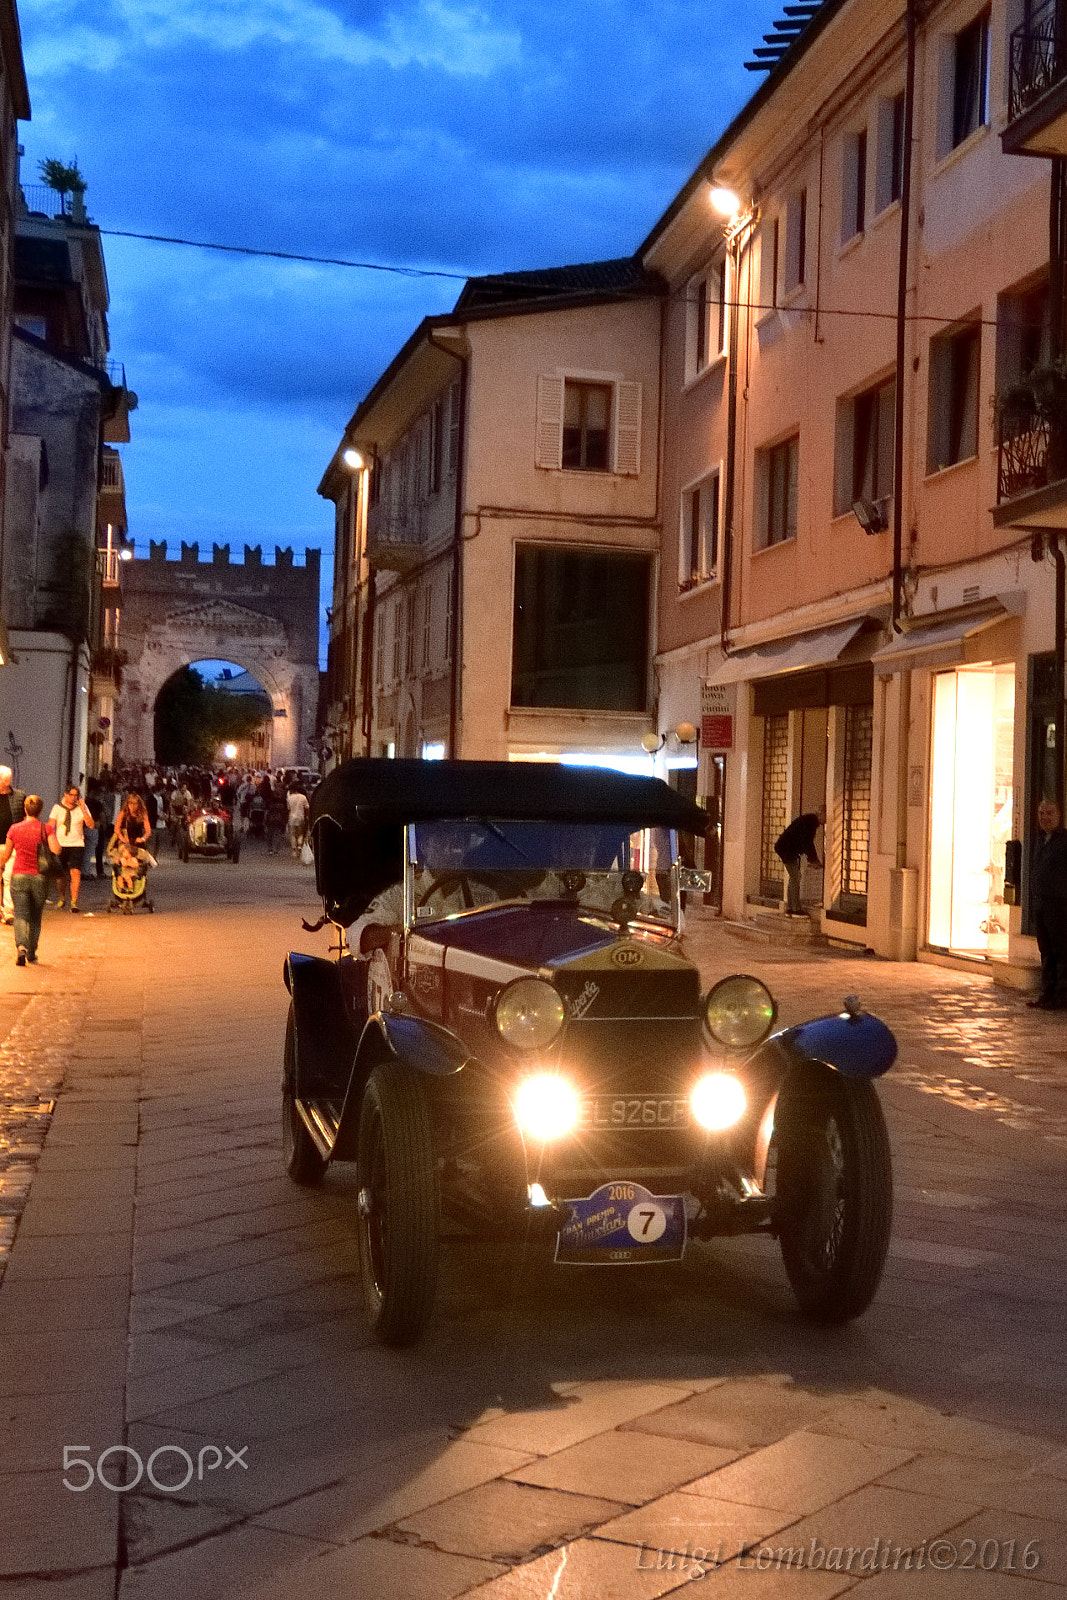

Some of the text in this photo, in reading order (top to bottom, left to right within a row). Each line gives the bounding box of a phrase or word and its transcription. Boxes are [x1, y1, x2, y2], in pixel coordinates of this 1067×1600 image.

[617, 951, 641, 964] OM
[608, 1185, 635, 1201] 2016
[639, 1211, 656, 1235] 7
